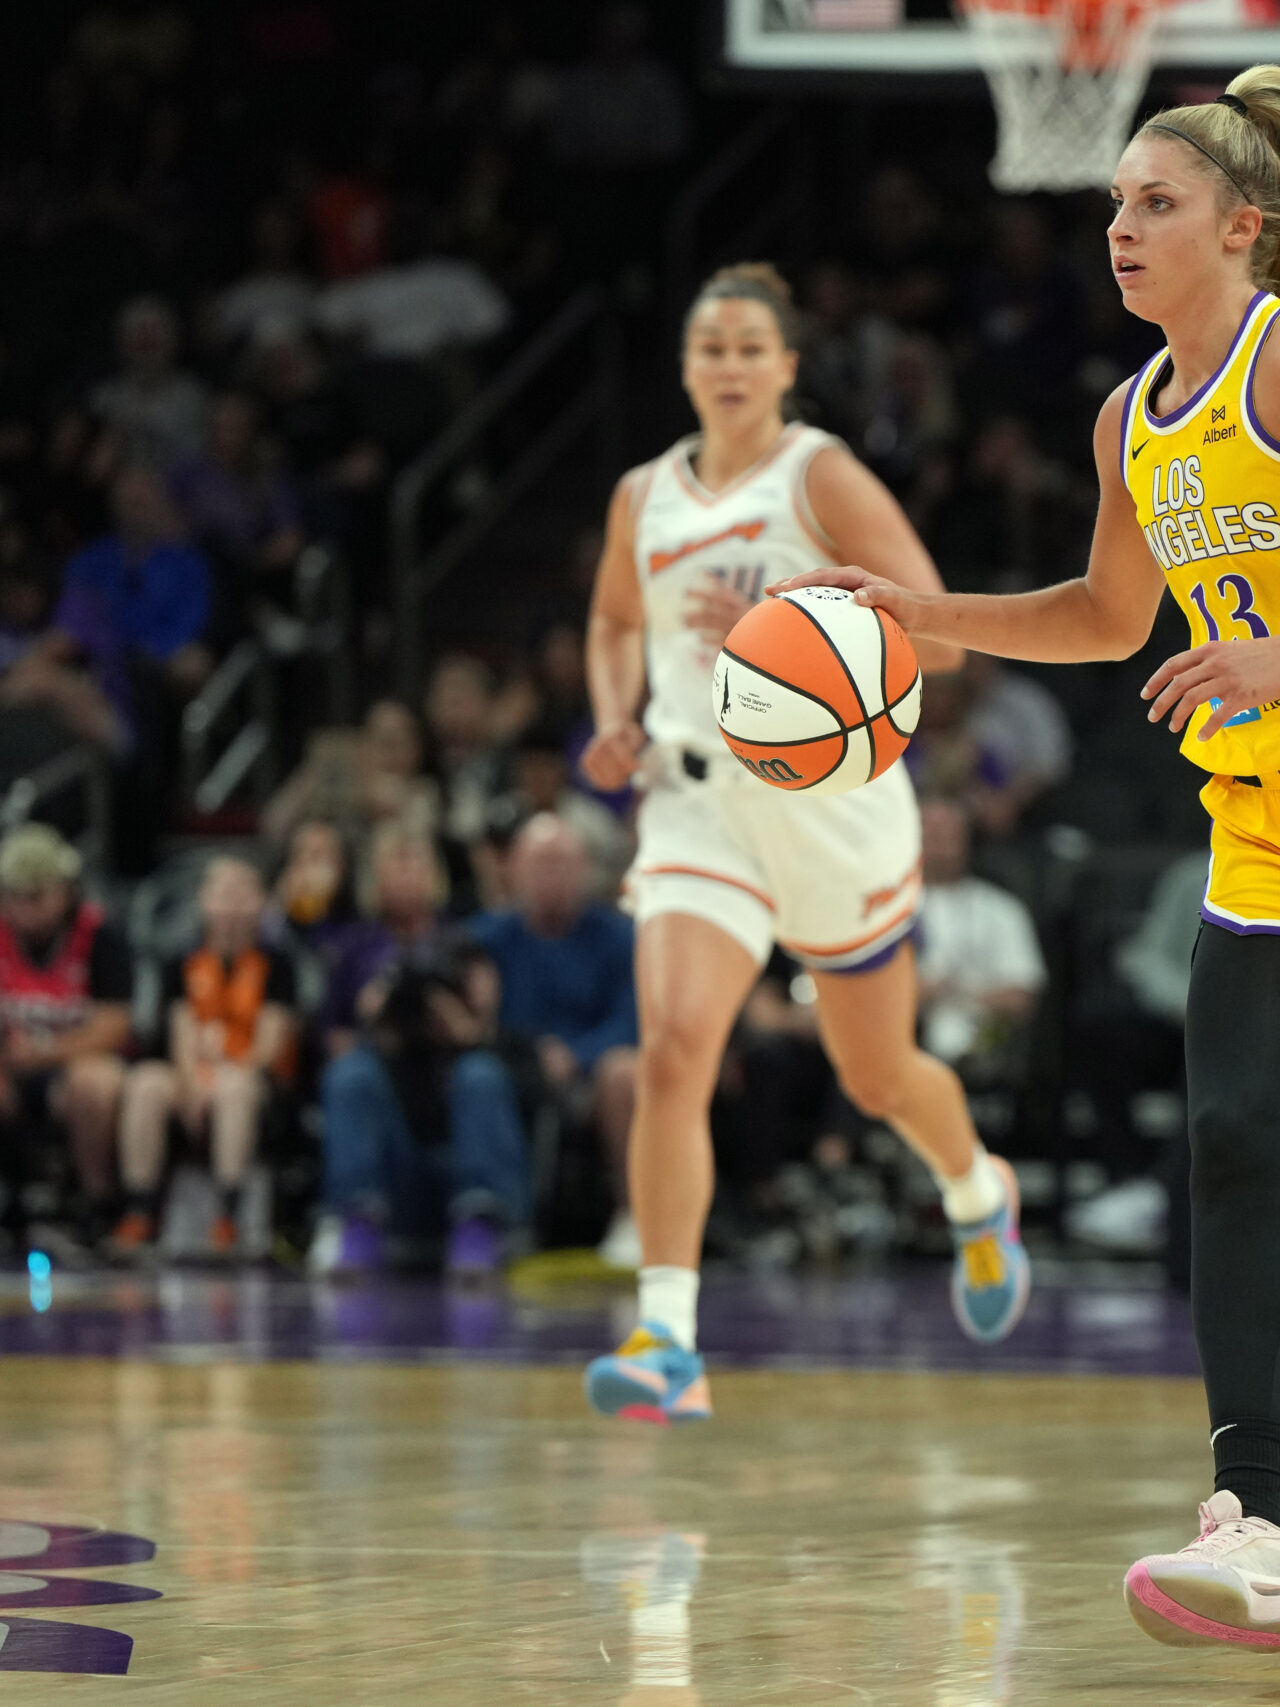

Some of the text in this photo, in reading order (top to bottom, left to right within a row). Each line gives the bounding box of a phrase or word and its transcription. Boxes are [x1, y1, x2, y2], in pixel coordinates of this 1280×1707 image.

[1202, 423, 1237, 446] Albert
[1152, 455, 1205, 517] LOS
[1189, 573, 1271, 641] 13
